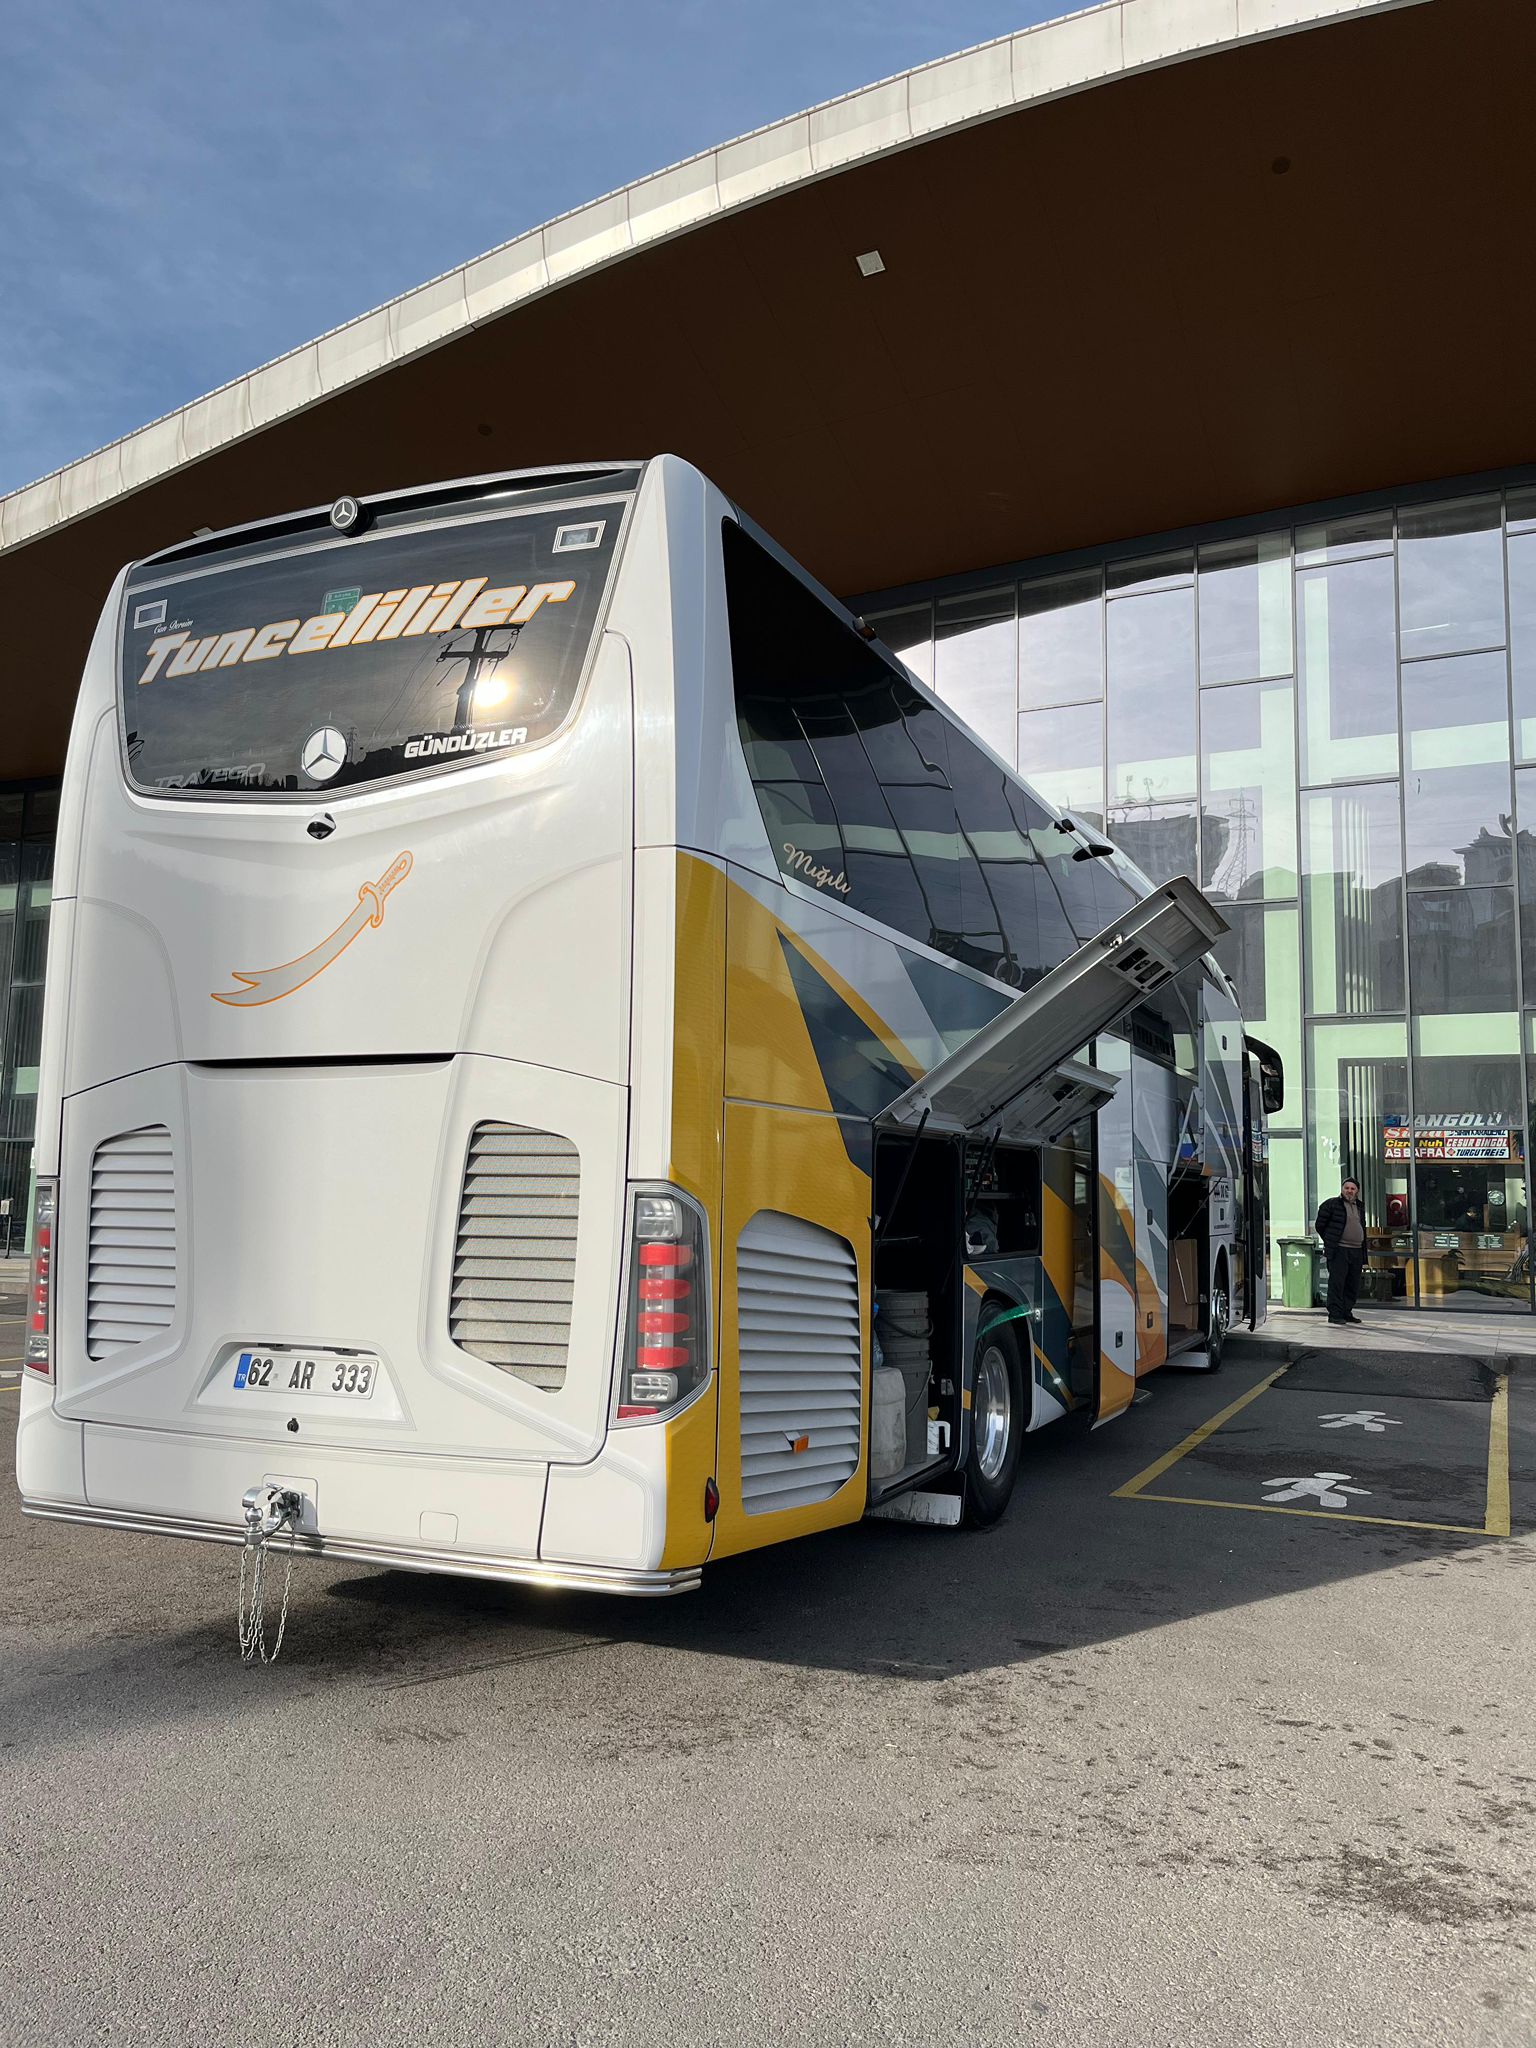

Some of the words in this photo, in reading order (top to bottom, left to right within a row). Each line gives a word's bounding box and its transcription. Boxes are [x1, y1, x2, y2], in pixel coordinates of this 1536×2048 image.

[138, 576, 576, 686] Tuncelililer
[403, 726, 528, 759] GÜNDÜZLER
[1385, 1148, 1401, 1158] AS
[1446, 1138, 1474, 1148] CESUR
[238, 1374, 246, 1382] TR
[248, 1358, 274, 1386] 62
[288, 1360, 316, 1390] AR
[331, 1363, 373, 1394] 333
